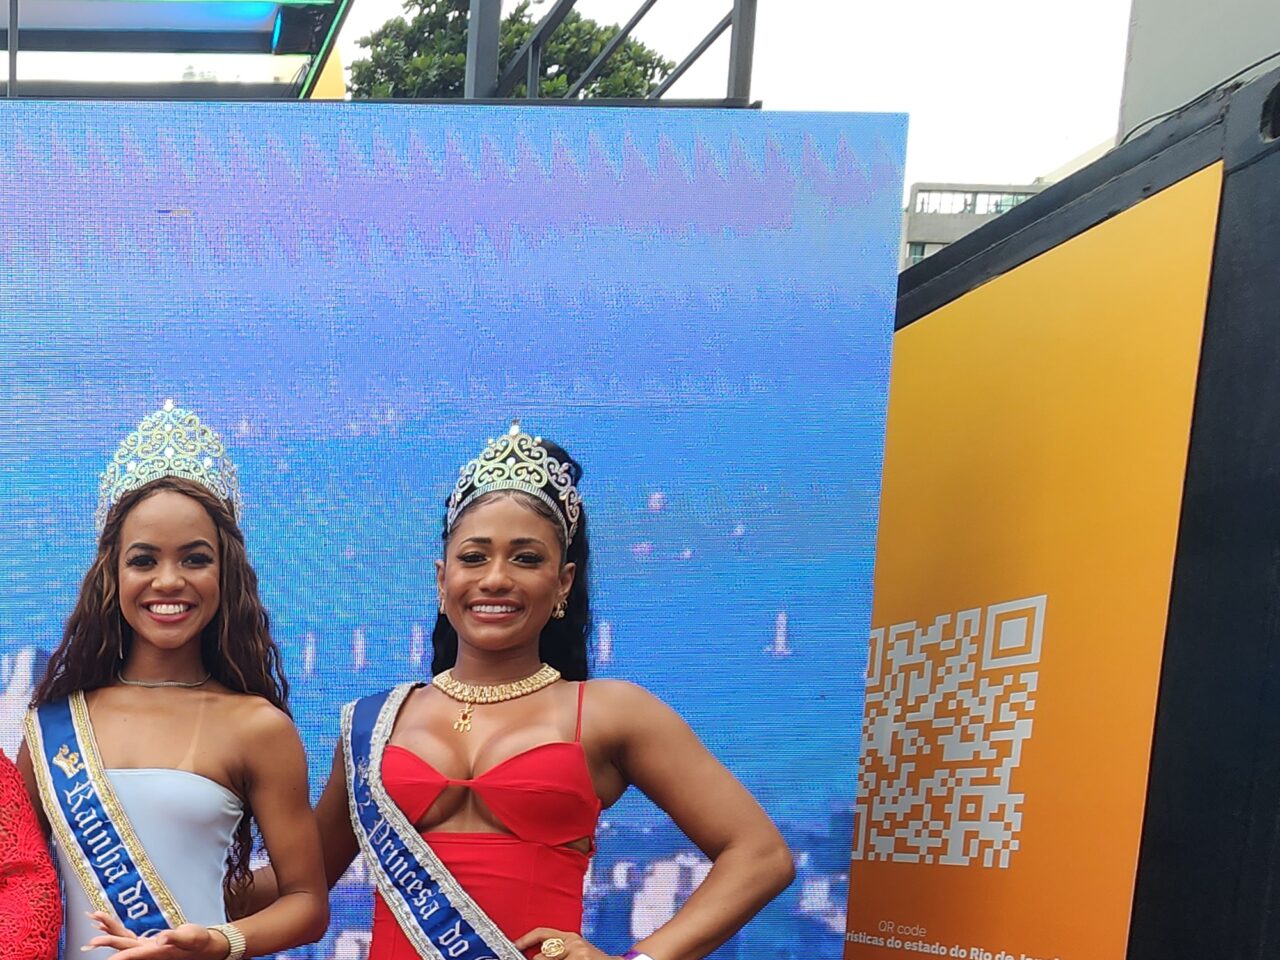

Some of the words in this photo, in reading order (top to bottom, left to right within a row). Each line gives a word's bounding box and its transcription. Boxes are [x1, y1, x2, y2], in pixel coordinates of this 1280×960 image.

[64, 780, 129, 884] Rainha
[118, 879, 149, 920] do
[368, 815, 440, 921] Princesa
[438, 921, 469, 957] do
[878, 920, 895, 933] QR
[897, 923, 927, 937] code
[886, 936, 902, 949] do
[904, 940, 947, 956] estado
[949, 945, 967, 959] do
